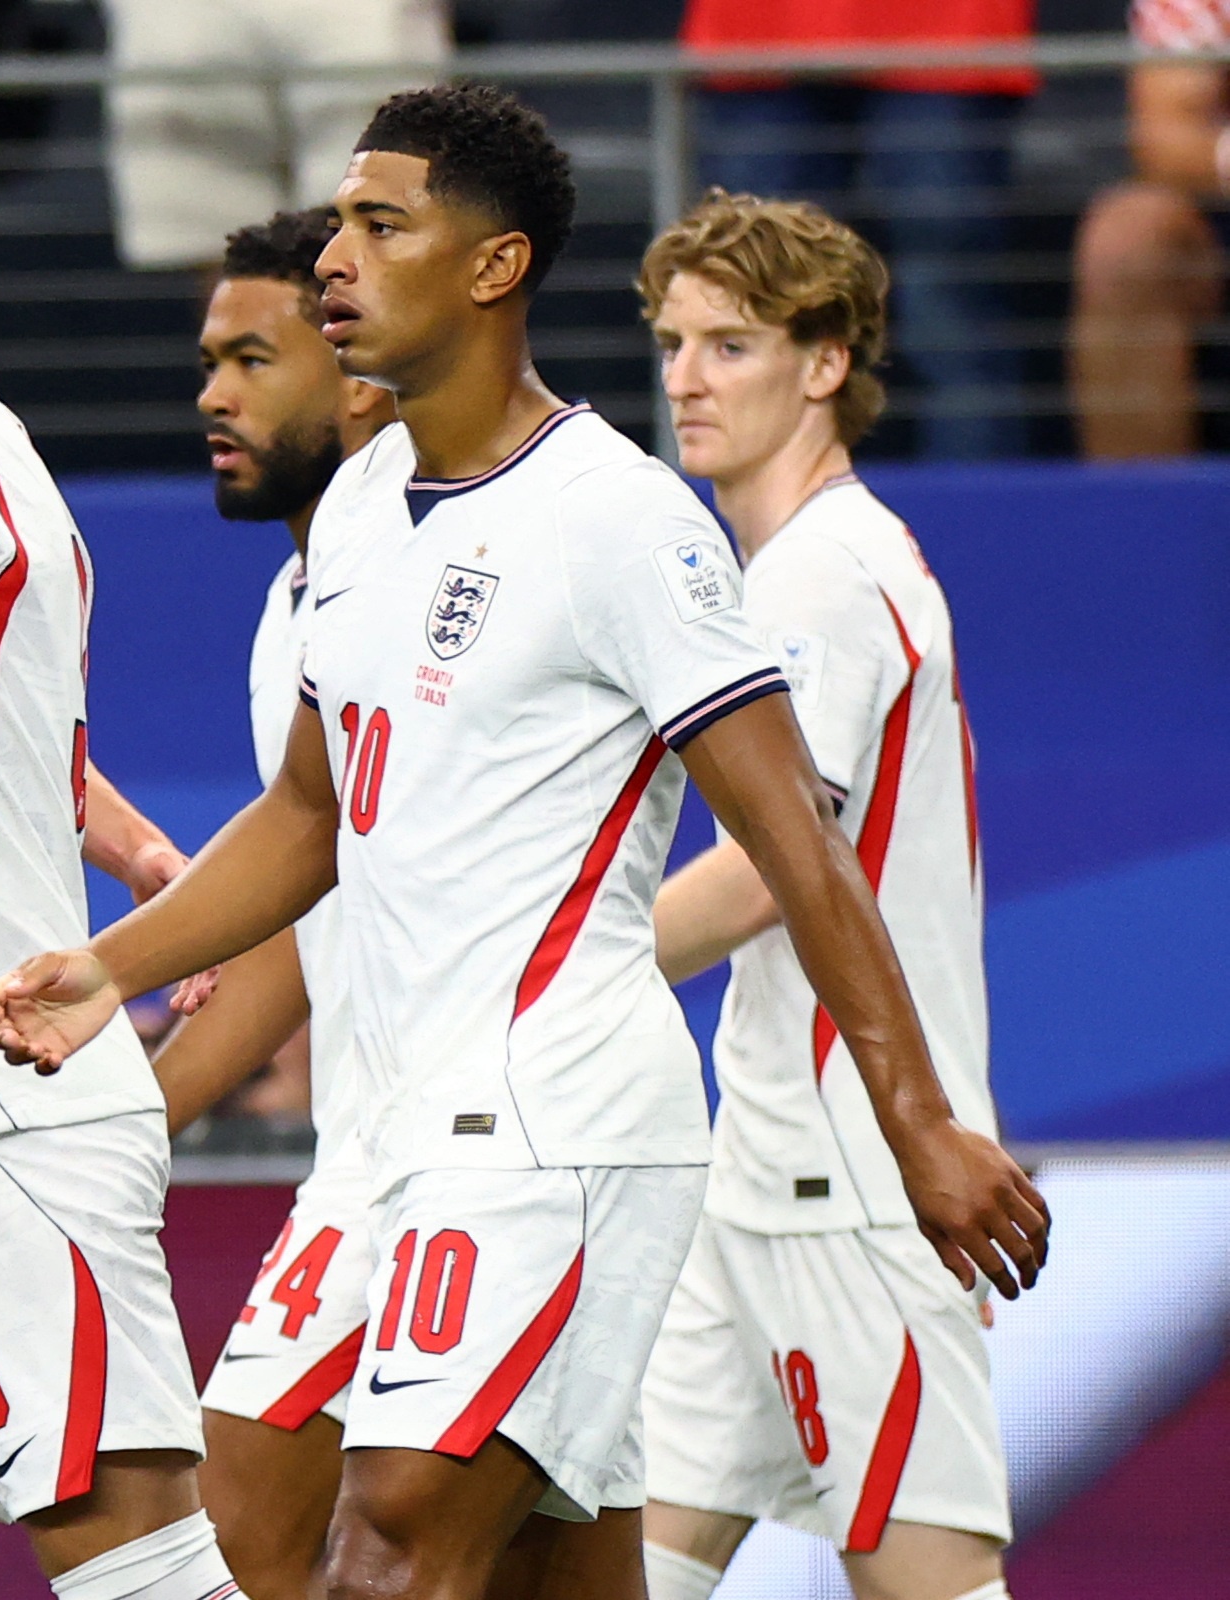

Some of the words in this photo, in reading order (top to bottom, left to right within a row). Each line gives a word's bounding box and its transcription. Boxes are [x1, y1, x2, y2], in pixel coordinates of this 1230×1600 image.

[689, 581, 722, 603] PEACE
[416, 664, 454, 686] CROATIA
[337, 700, 392, 838] 10
[376, 1228, 478, 1355] 10
